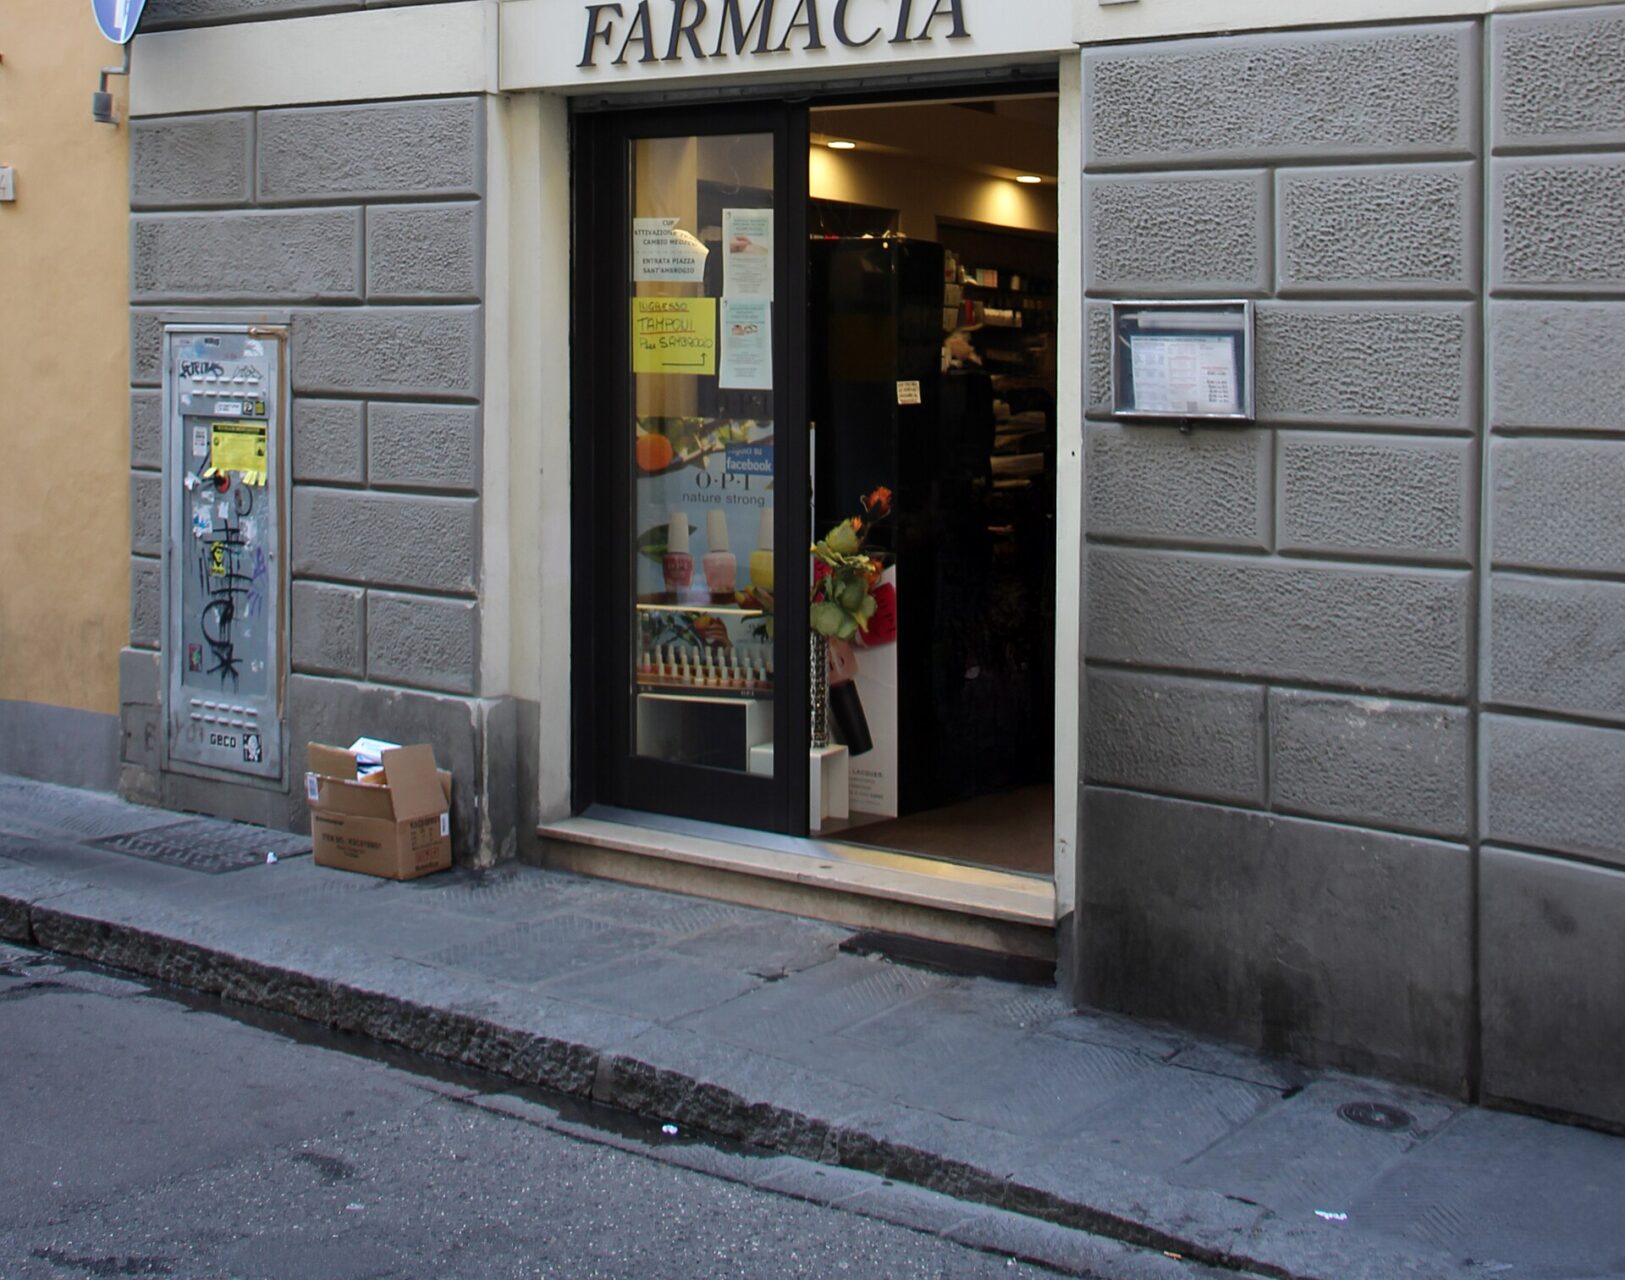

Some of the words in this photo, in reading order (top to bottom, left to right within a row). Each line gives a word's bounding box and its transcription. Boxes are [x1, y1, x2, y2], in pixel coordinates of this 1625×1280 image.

[727, 456, 772, 472] facebook
[682, 493, 721, 503] nature
[726, 494, 765, 507] strong
